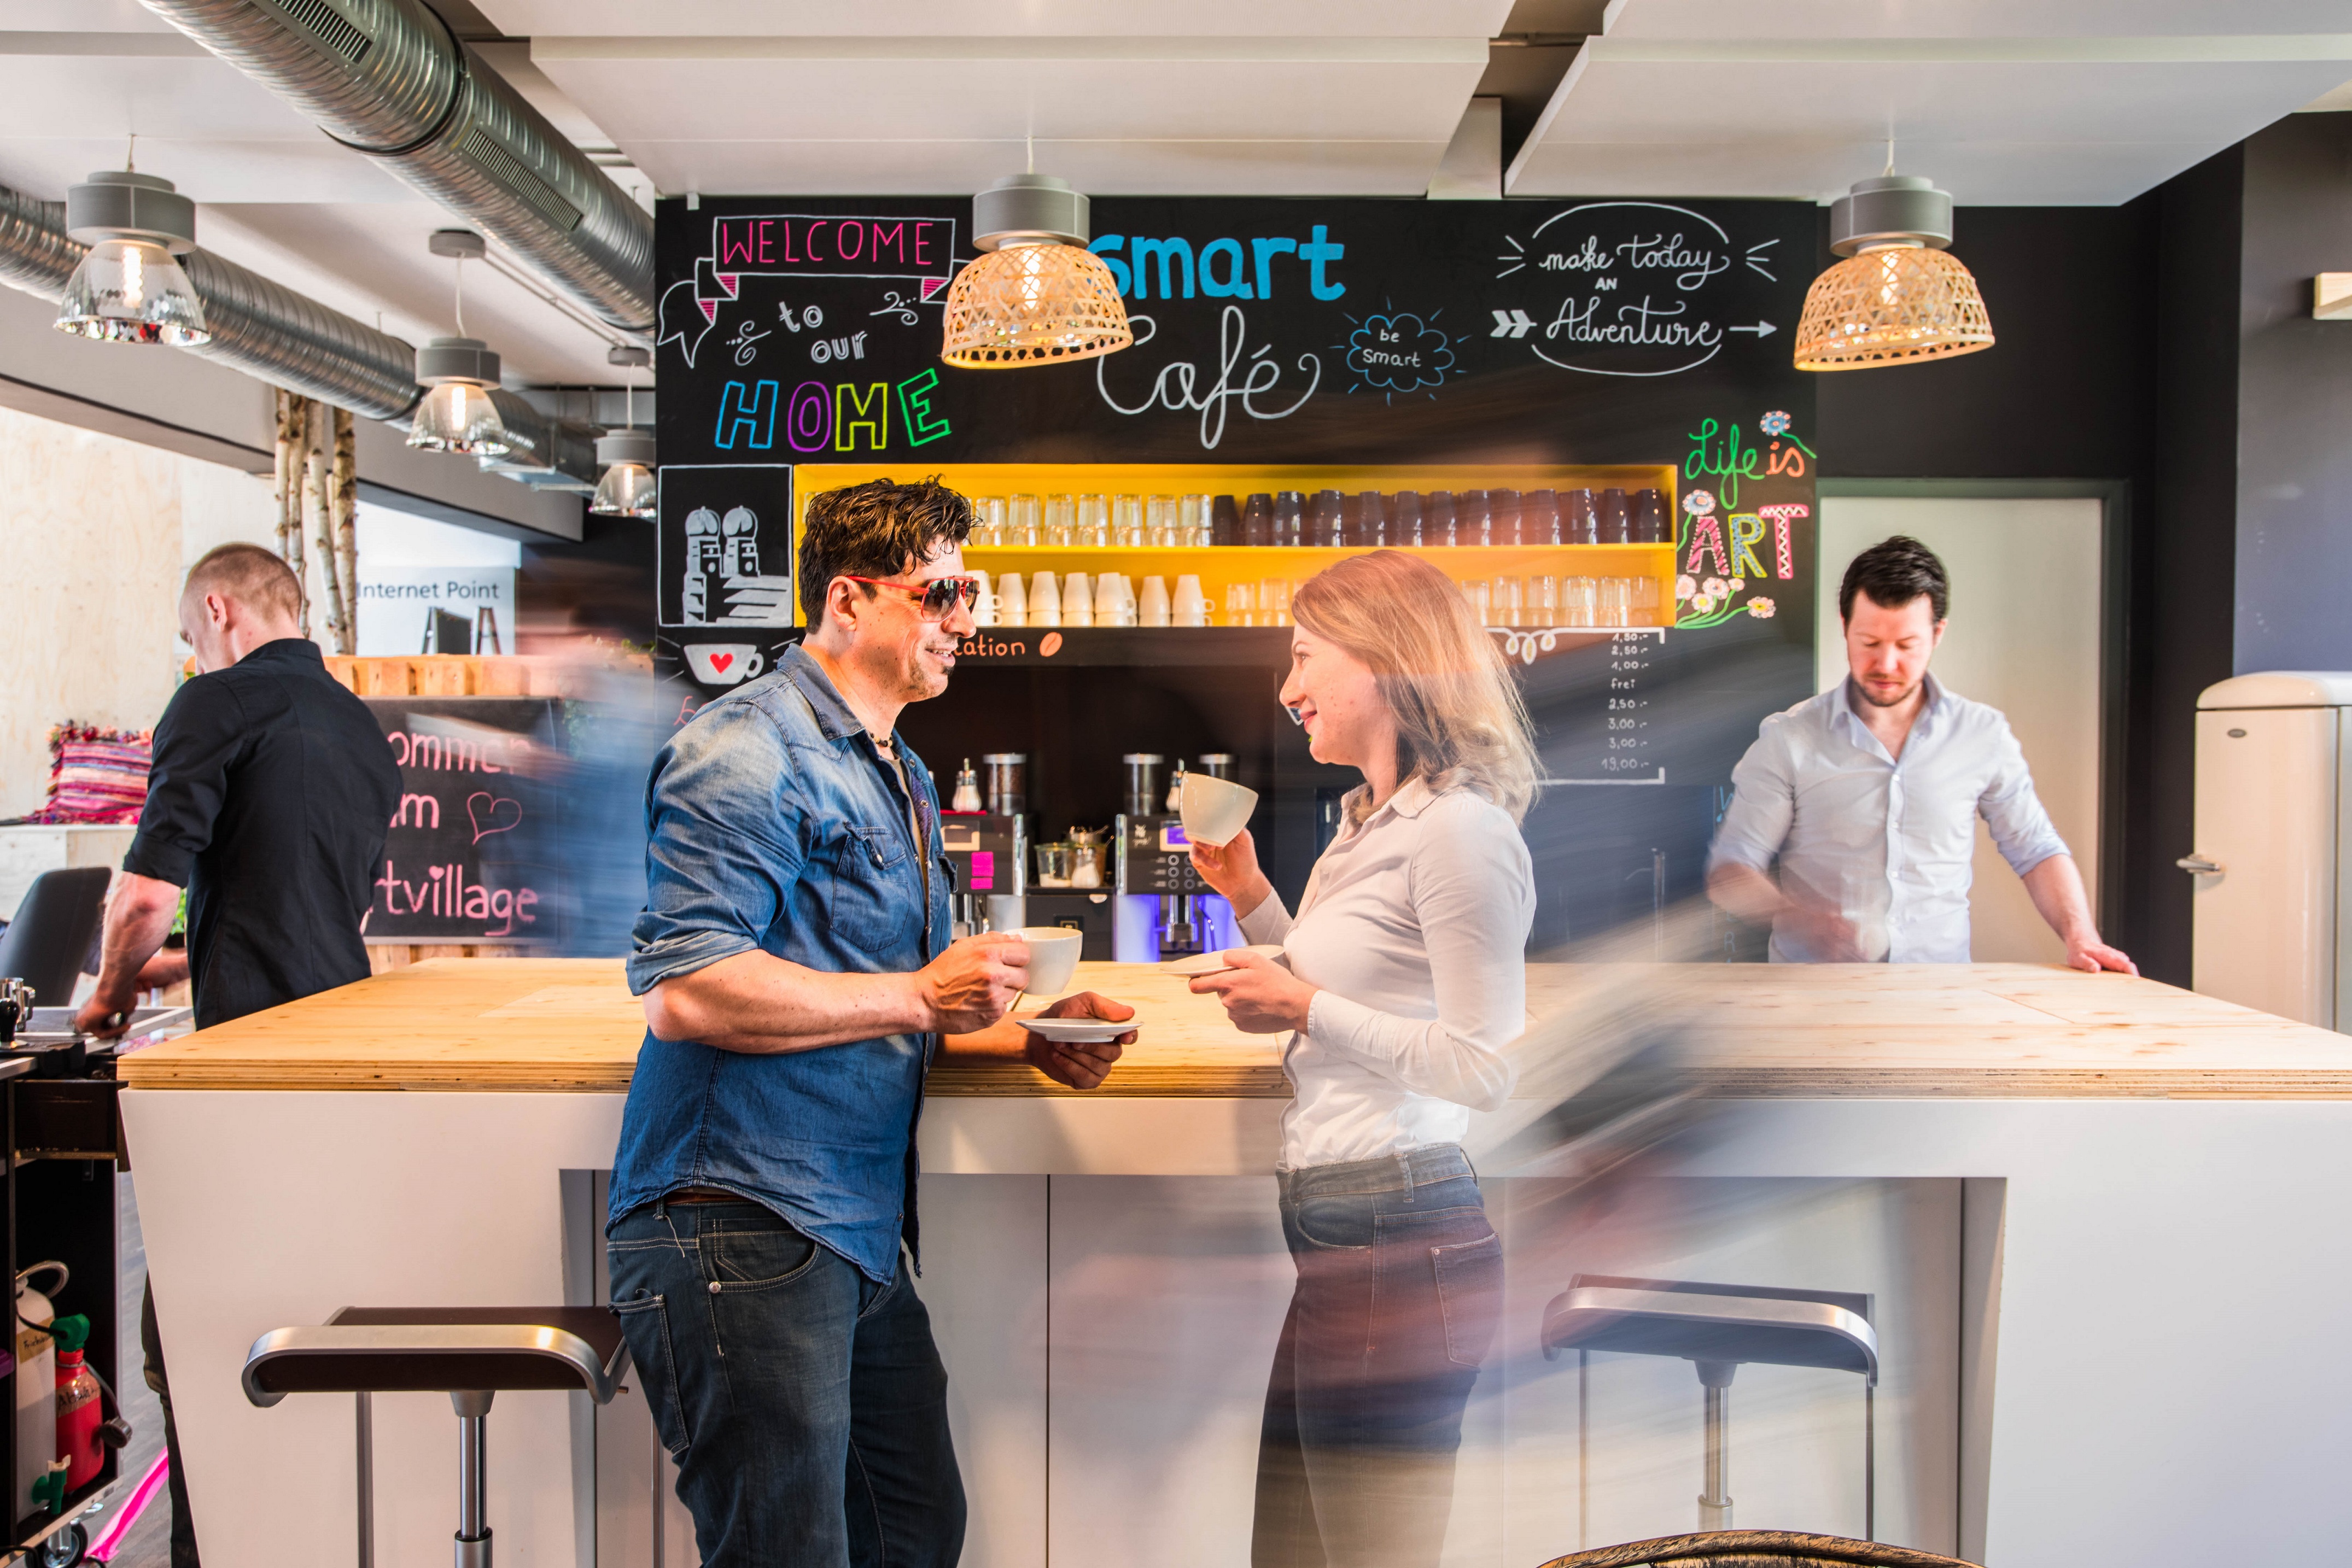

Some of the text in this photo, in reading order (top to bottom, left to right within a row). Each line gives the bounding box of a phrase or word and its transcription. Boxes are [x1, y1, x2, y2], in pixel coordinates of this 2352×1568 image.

[722, 220, 933, 265] WELCOME
[1086, 224, 1347, 301] smart
[1538, 233, 1730, 291] make today
[1595, 278, 1617, 290] AN
[779, 301, 823, 332] to
[1380, 329, 1400, 342] be
[1546, 295, 1722, 347] Adventure
[811, 330, 868, 364] our
[1097, 305, 1321, 449] Café
[715, 367, 952, 452] HOME
[1766, 441, 1805, 477] is
[1686, 504, 1809, 580] ART
[356, 581, 500, 599] Internet Point
[1610, 678, 1635, 689] frei
[370, 859, 539, 936] tvillage
